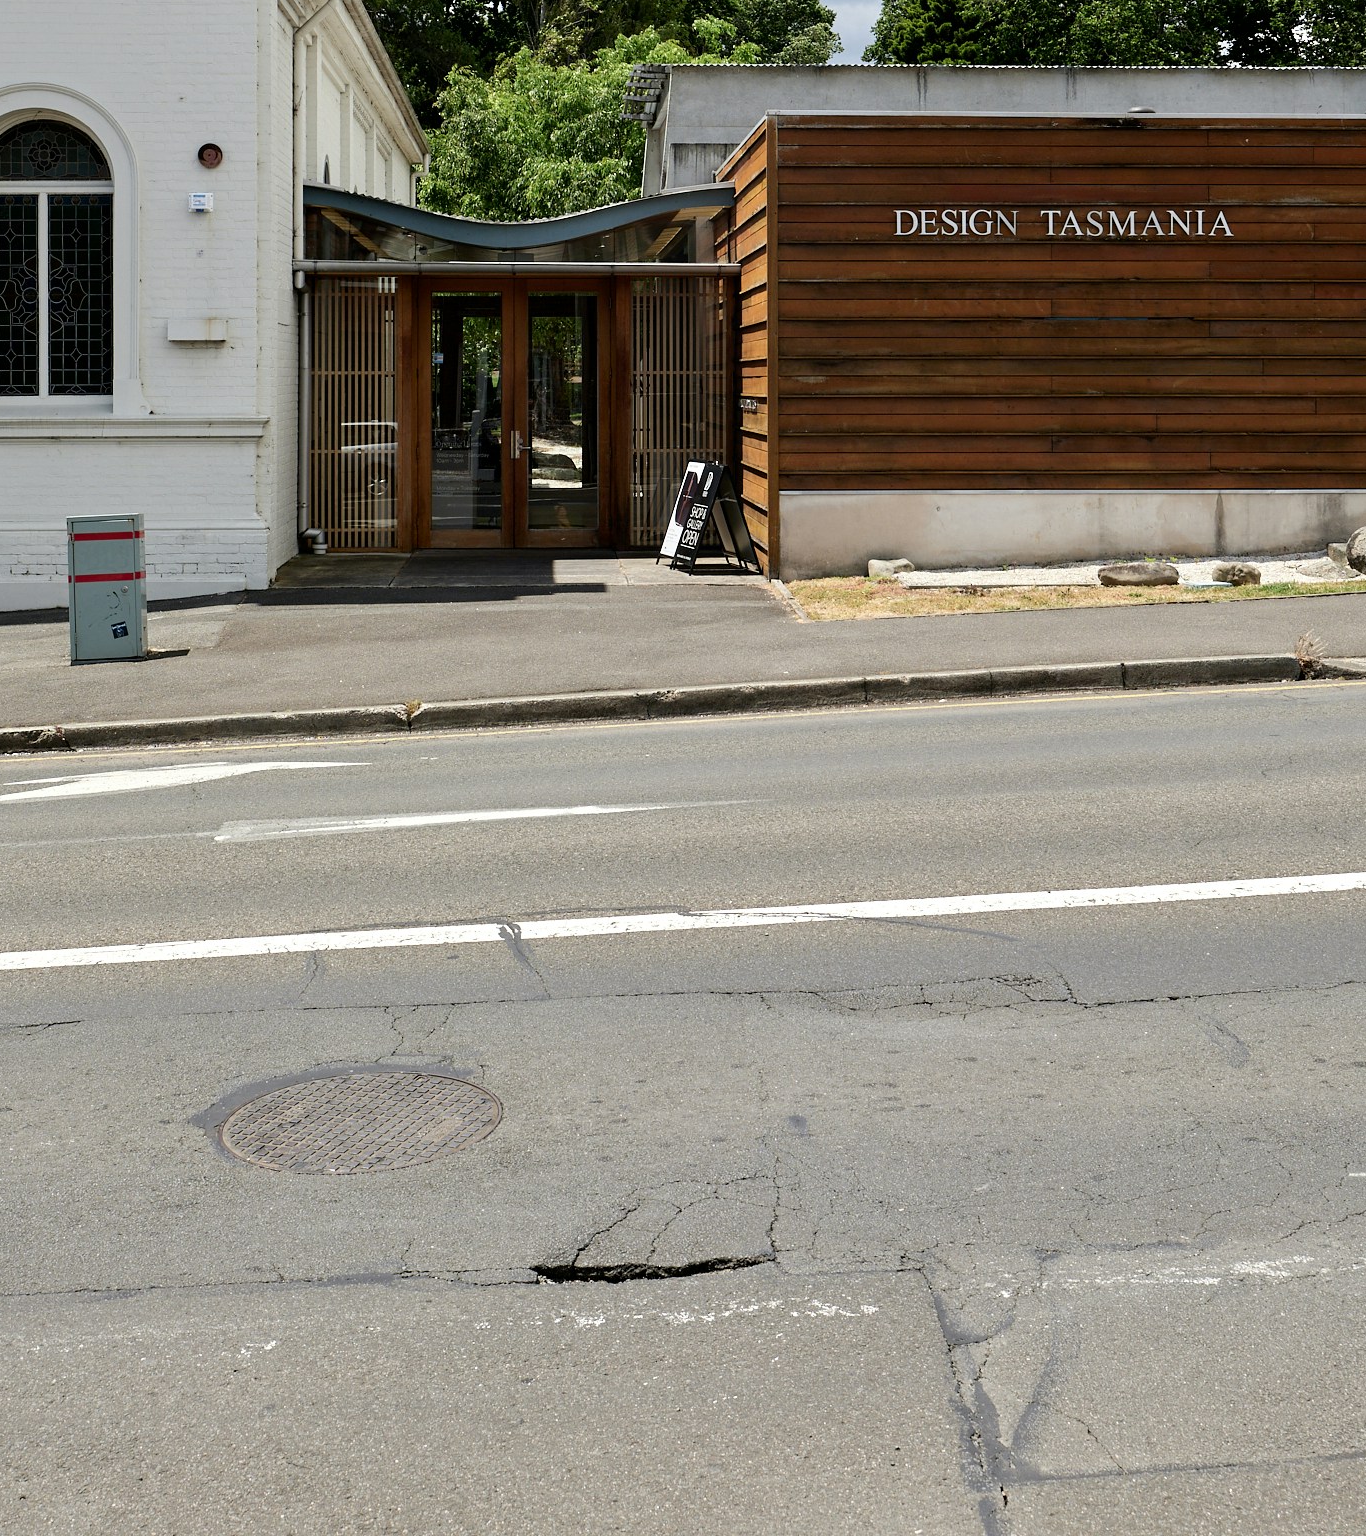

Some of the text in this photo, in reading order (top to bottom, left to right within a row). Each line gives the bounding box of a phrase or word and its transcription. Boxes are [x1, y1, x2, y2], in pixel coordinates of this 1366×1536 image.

[893, 209, 1234, 237] DESIGN TASMANIA
[690, 506, 704, 519] SHOP
[682, 529, 700, 546] OPEN
